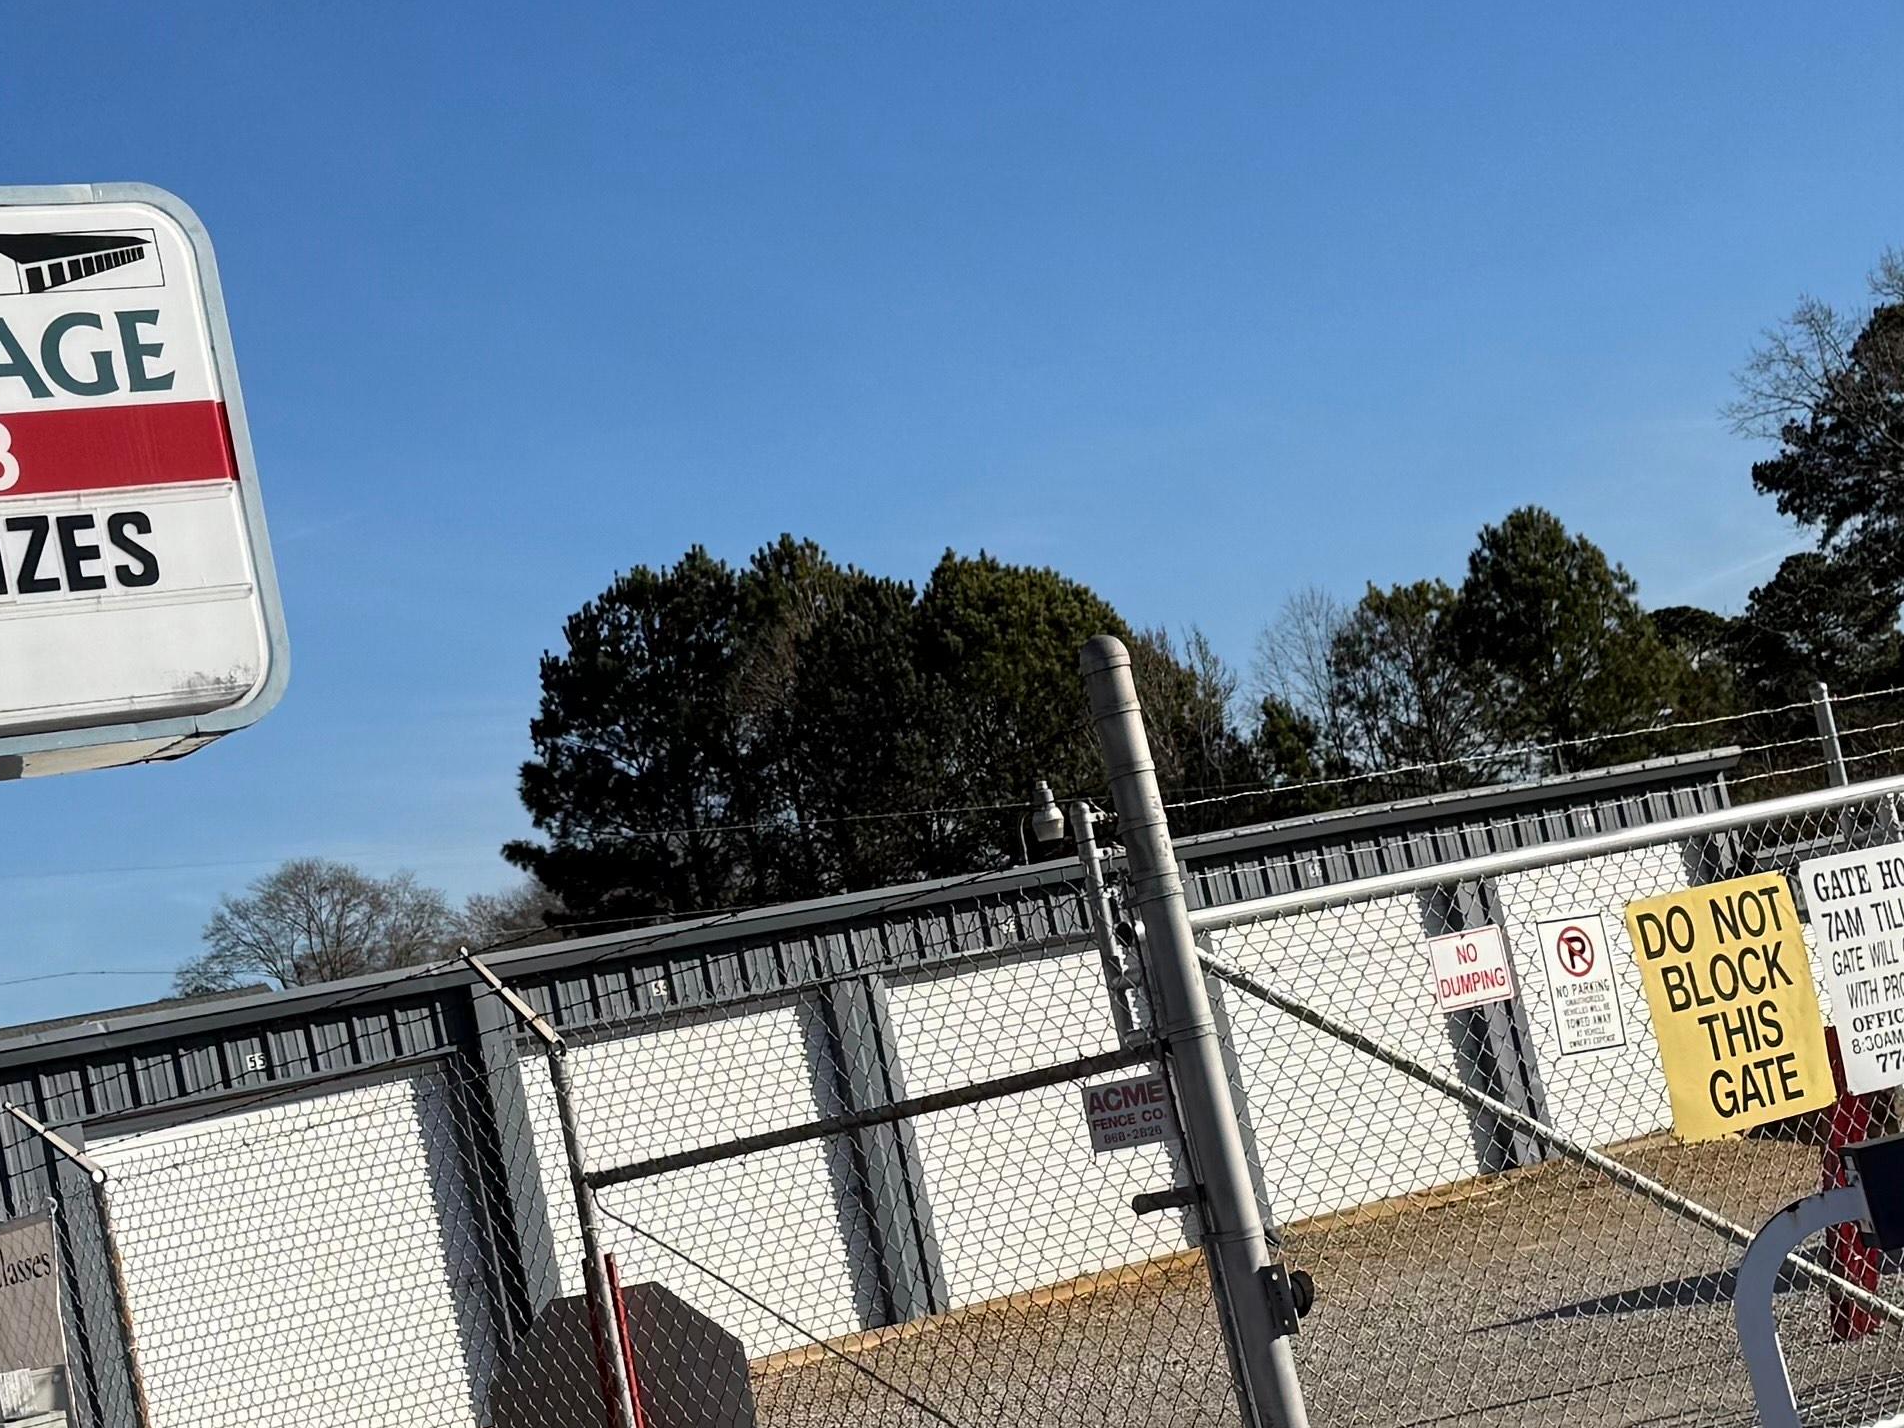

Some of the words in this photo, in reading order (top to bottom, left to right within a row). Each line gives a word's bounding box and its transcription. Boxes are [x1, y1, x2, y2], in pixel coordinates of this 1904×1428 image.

[1813, 864, 1872, 903] GATE
[1635, 905, 1696, 961] DO
[1709, 885, 1782, 945] NOT
[1821, 906, 1866, 942] 7AM
[1456, 943, 1478, 965] NO
[1832, 945, 1865, 977] GATE
[1868, 939, 1899, 969] WILL
[1440, 967, 1506, 998] DUMPING
[1556, 984, 1569, 998] NO
[1571, 978, 1610, 997] PARKING
[1661, 940, 1794, 1013] BLOCK
[1846, 976, 1879, 1010] WITH
[1697, 999, 1784, 1062] THIS
[1851, 1028, 1904, 1055] 8:30AM
[1088, 1079, 1166, 1115] ACME
[1709, 1052, 1804, 1119] GATE
[1092, 1112, 1137, 1131] FENCE
[1142, 1108, 1167, 1122] CO.
